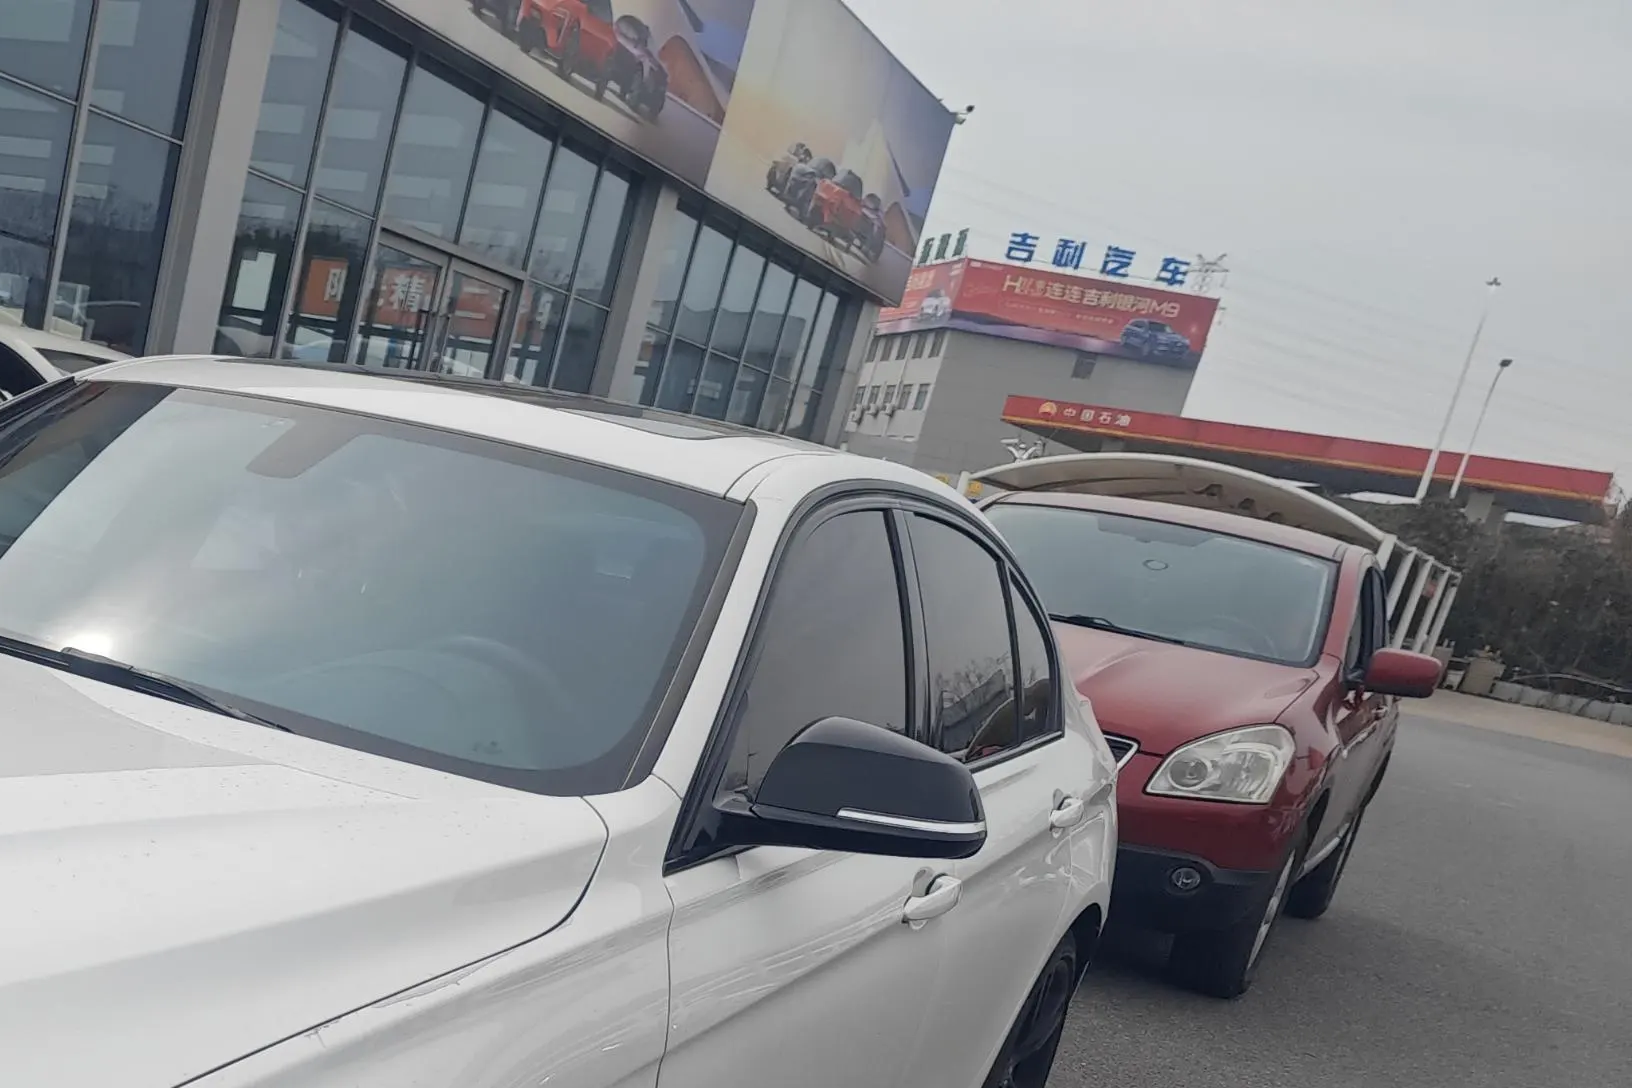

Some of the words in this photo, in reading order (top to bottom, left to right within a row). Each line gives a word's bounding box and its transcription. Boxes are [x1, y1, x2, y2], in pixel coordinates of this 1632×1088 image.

[1005, 232, 1191, 286] 吉利汽车
[1062, 407, 1132, 427] 中国石油
